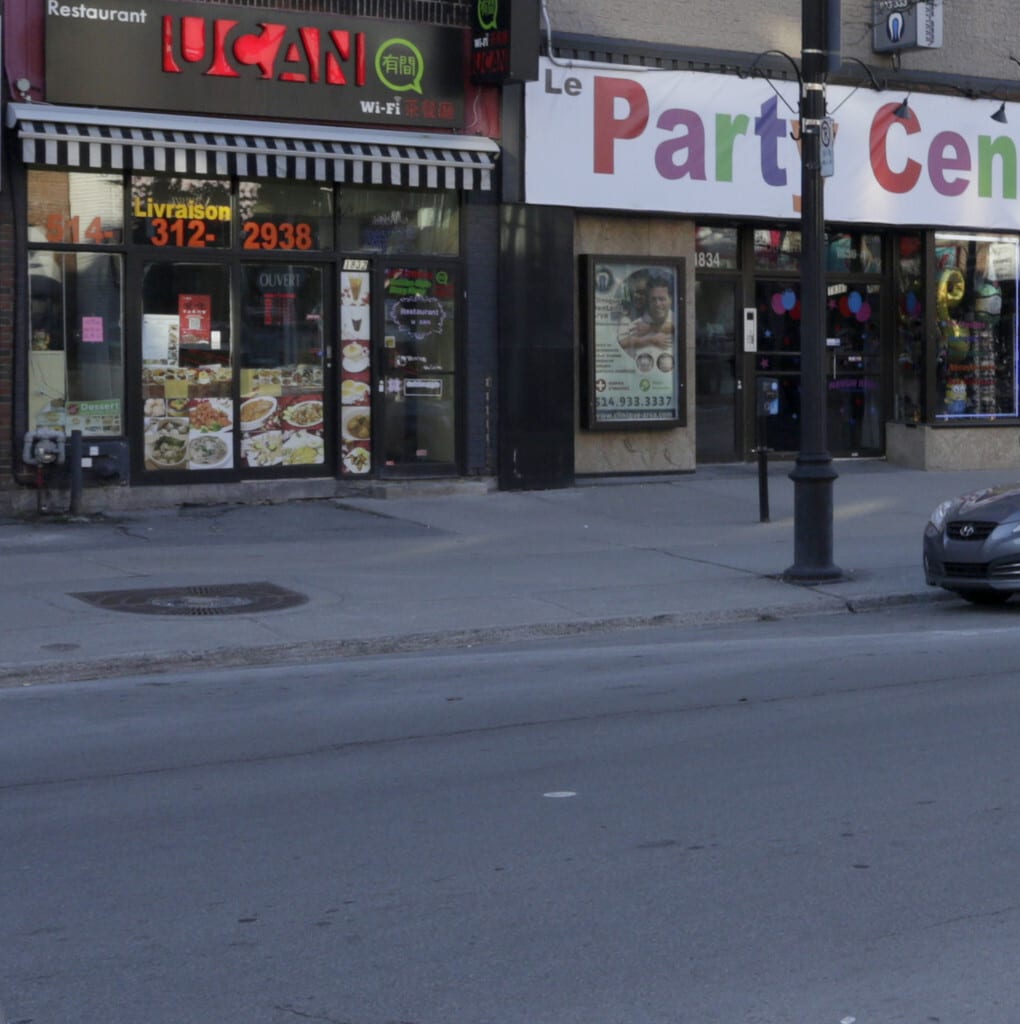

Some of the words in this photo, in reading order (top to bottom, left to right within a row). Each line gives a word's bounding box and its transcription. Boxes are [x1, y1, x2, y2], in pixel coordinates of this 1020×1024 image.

[47, 0, 148, 24] Restaurant
[161, 14, 366, 87] UCAN
[544, 68, 582, 96] Le
[360, 100, 401, 116] Wi-Fi
[133, 195, 231, 222] Livraison
[45, 214, 113, 244] 514-
[151, 218, 216, 248] 312-
[242, 222, 313, 251] 2938
[694, 252, 720, 268] 1834
[259, 273, 301, 288] OUVERT
[80, 402, 120, 413] Dessert
